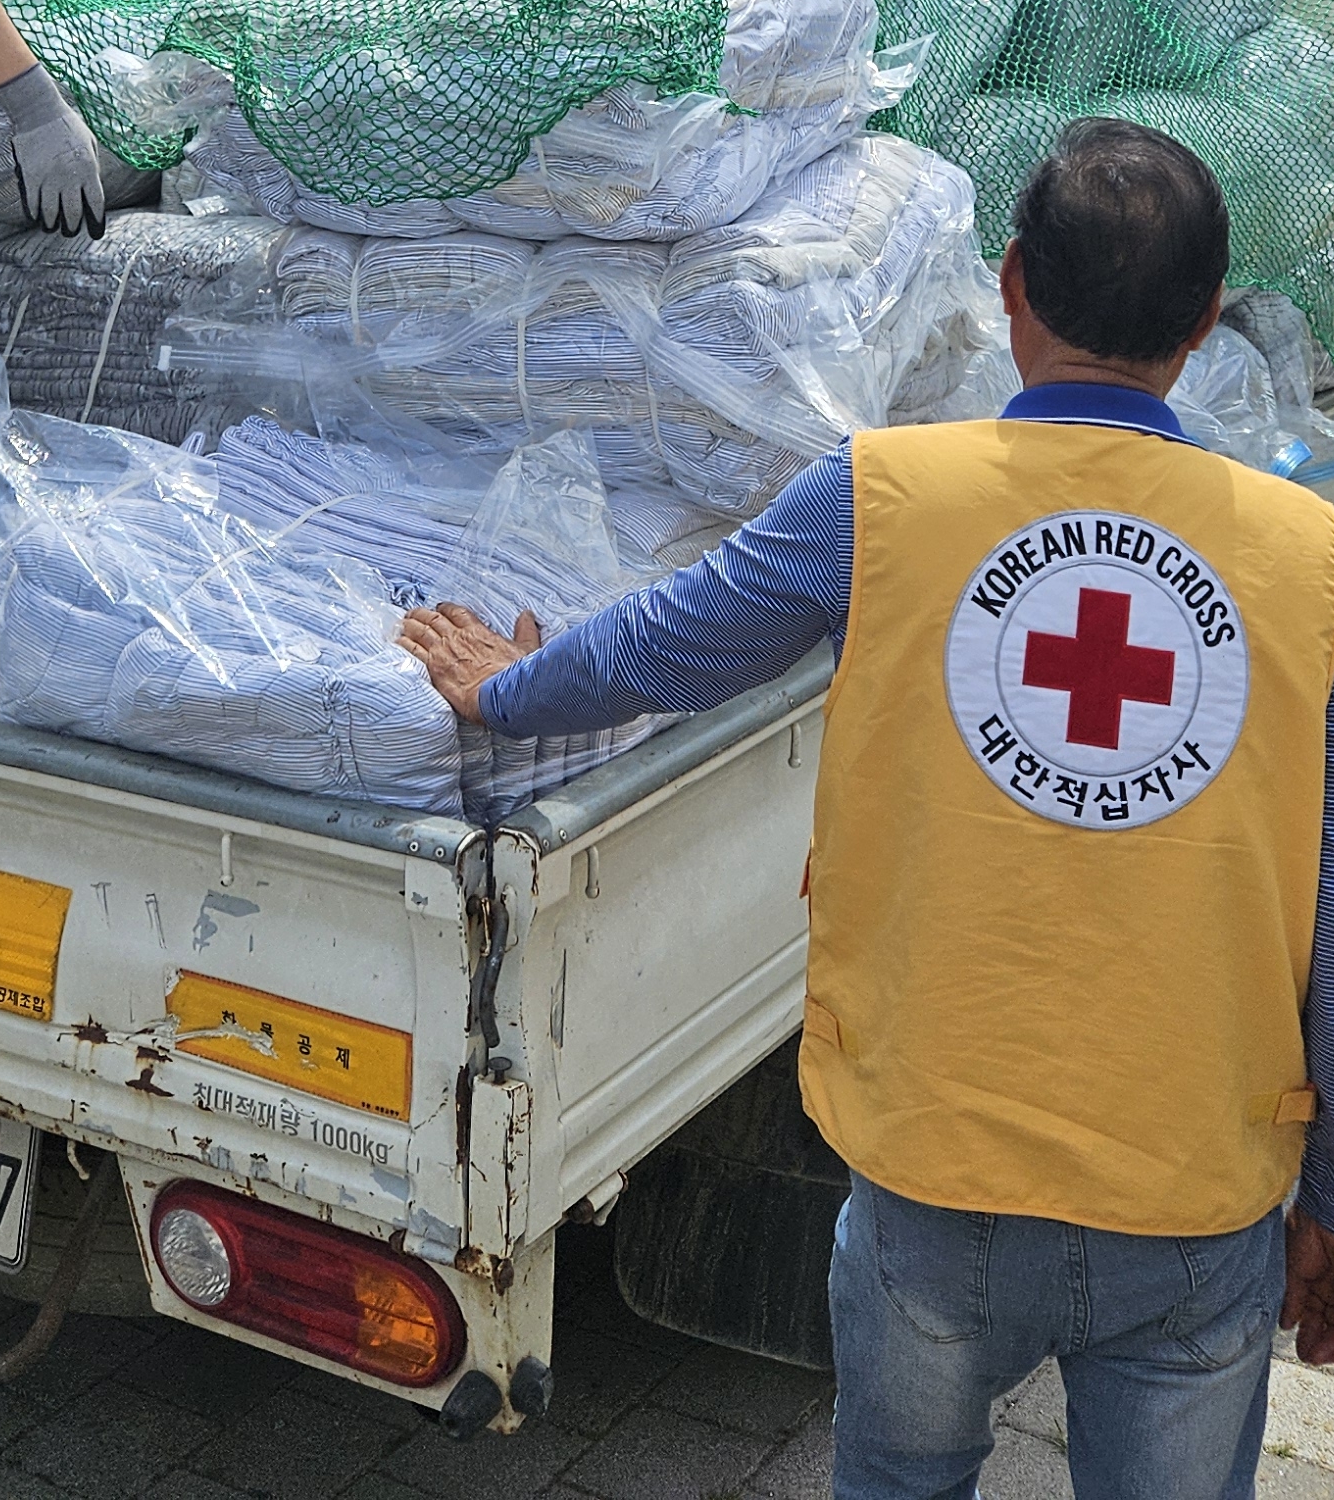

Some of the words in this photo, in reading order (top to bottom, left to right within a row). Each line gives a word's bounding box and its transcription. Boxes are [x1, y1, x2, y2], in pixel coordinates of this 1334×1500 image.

[970, 520, 1087, 618] KOREAN
[1095, 520, 1156, 566] RED
[1155, 546, 1237, 648] CROSS
[977, 713, 1212, 821] 대한적십자사
[192, 1082, 301, 1137] 최대적재량
[310, 1118, 388, 1165] 1000kg
